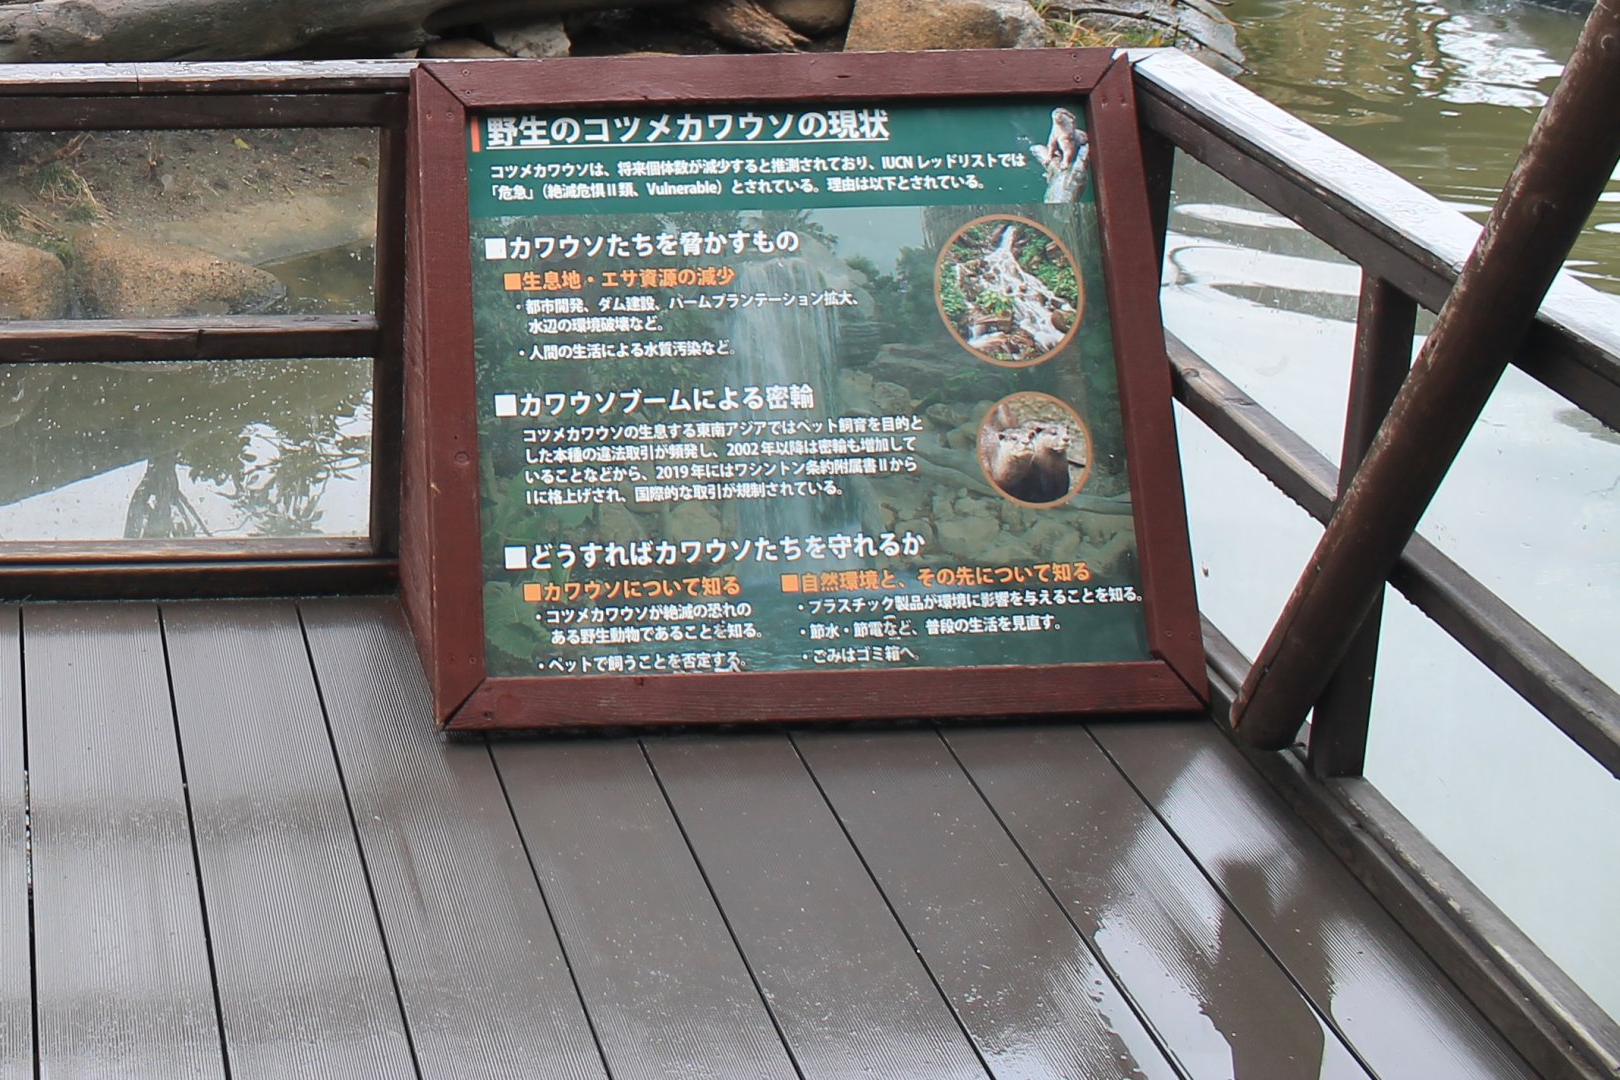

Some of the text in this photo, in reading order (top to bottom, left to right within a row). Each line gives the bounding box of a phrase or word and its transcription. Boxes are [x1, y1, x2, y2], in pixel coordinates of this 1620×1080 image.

[486, 109, 890, 147] 野生のコツメカワウソの現状
